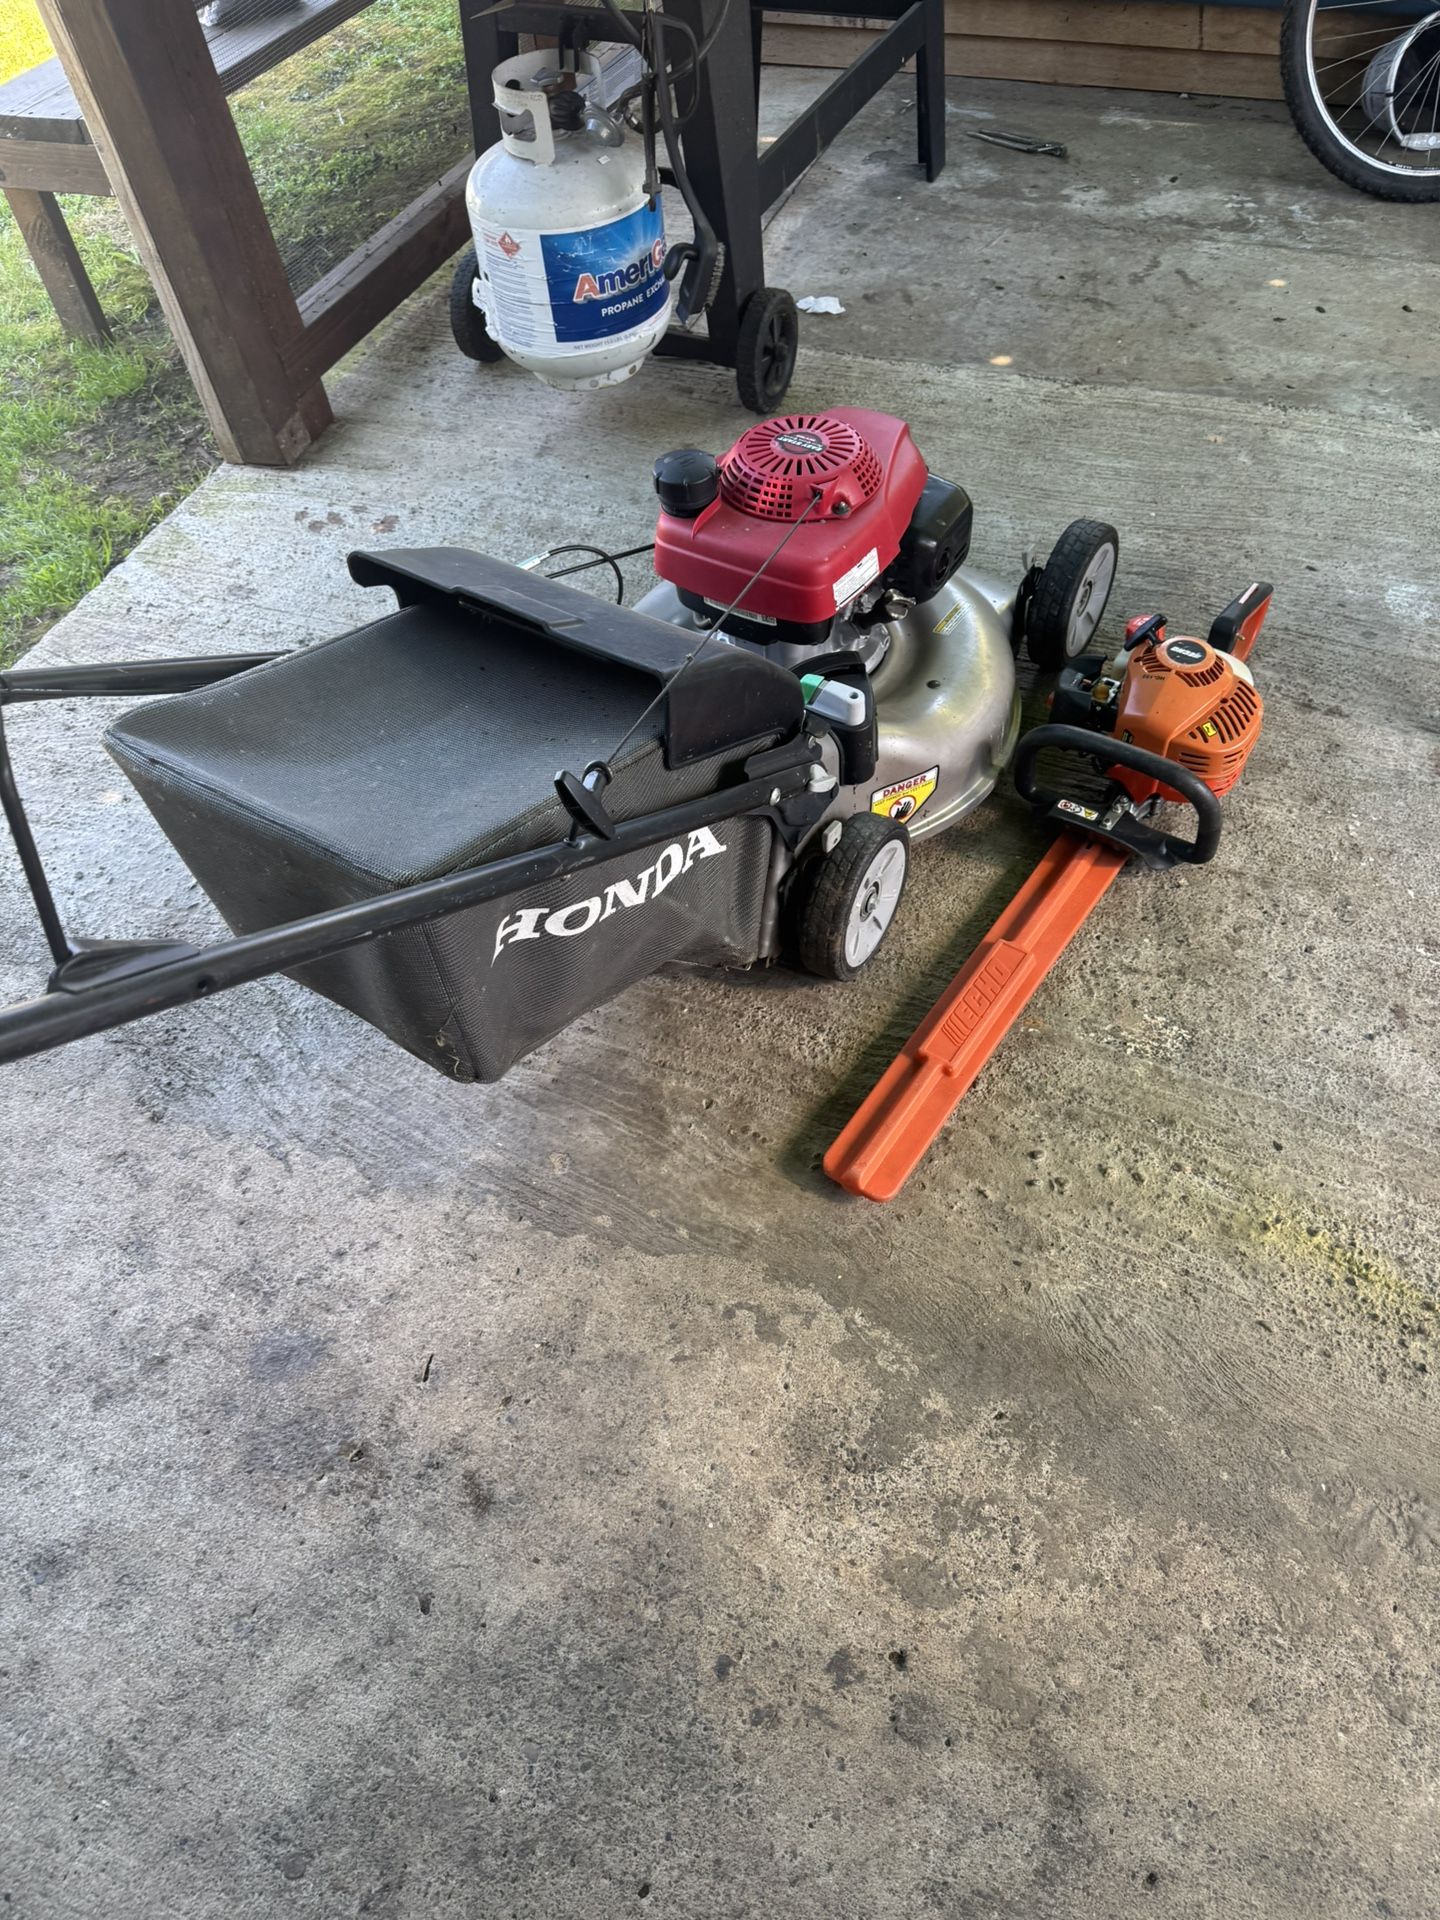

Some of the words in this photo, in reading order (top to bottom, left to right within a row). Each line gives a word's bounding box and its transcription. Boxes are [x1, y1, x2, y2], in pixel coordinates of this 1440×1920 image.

[601, 293, 644, 317] PROPANE
[883, 775, 927, 797] DANGER
[490, 826, 727, 968] HONDA
[947, 963, 1012, 1037] ECHO
